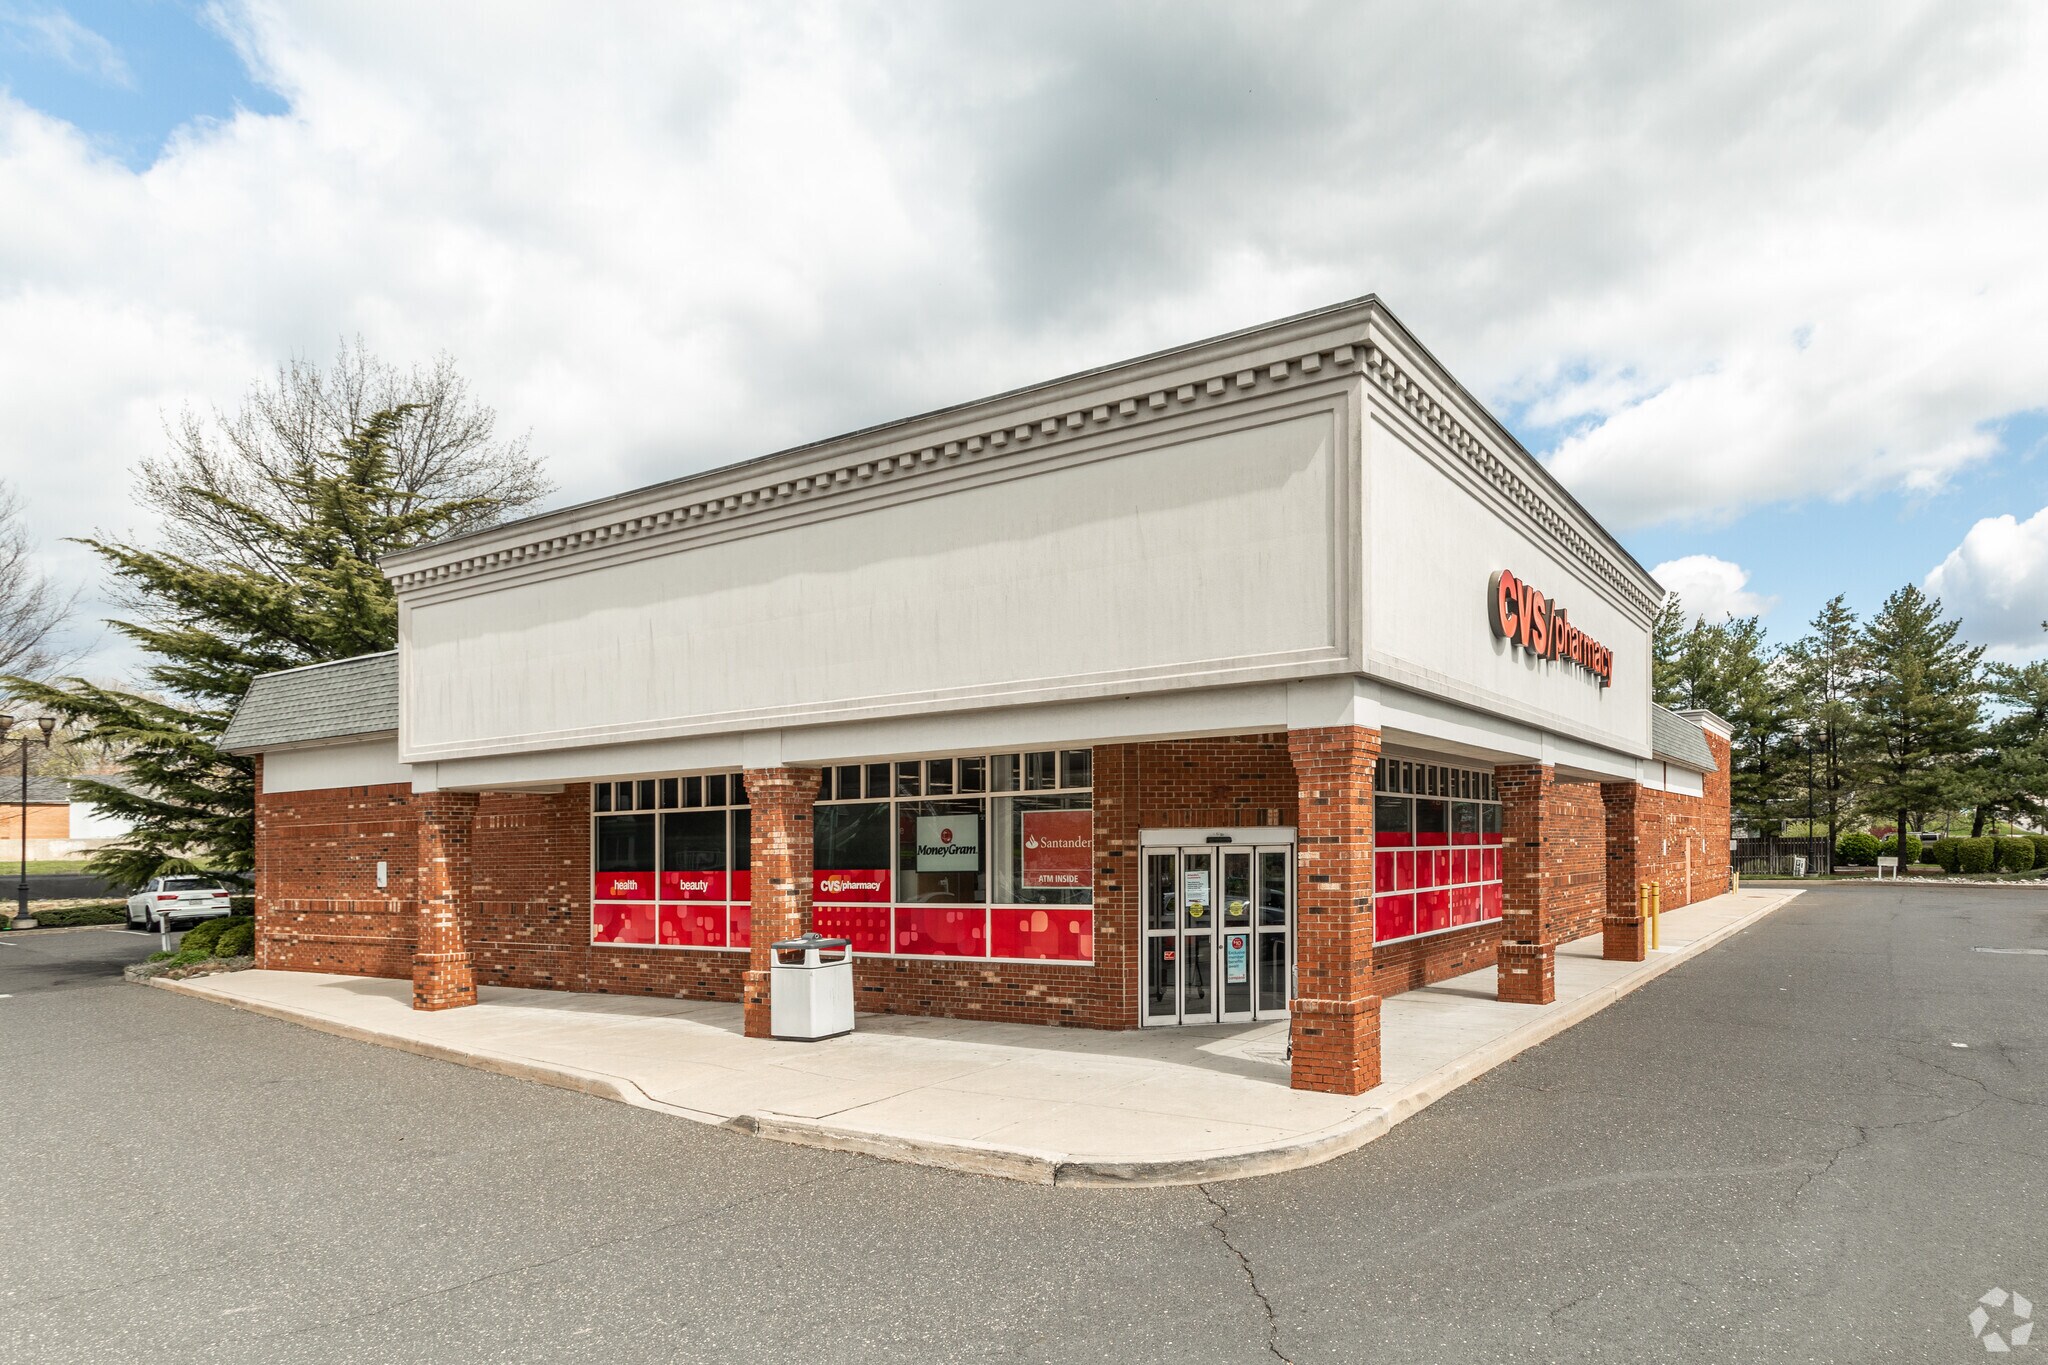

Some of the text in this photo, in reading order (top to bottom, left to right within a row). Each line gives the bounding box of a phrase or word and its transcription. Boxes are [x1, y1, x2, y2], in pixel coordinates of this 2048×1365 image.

[1497, 569, 1613, 688] CVS/pharmacy
[1040, 835, 1092, 849] Santander
[917, 844, 977, 857] MoneyGram
[614, 880, 637, 890] health
[820, 880, 881, 891] CVS/pharmacy
[1039, 875, 1079, 883] ATM INSIDE
[680, 879, 708, 893] beauty
